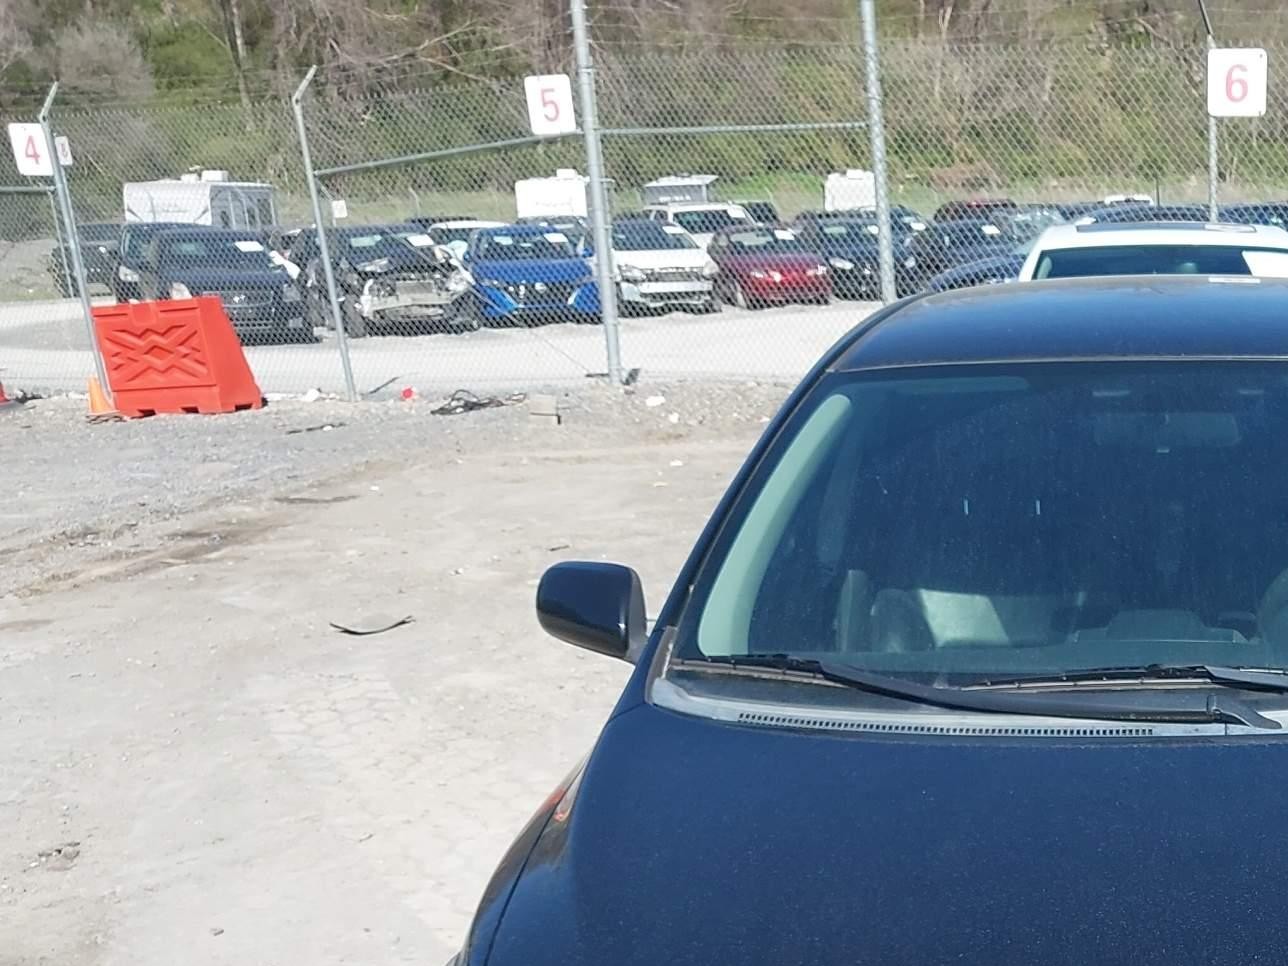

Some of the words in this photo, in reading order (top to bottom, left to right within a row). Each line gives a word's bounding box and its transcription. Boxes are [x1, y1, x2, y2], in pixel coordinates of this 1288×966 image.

[1225, 63, 1249, 103] 6
[540, 87, 560, 123] 5
[25, 134, 41, 166] 4
